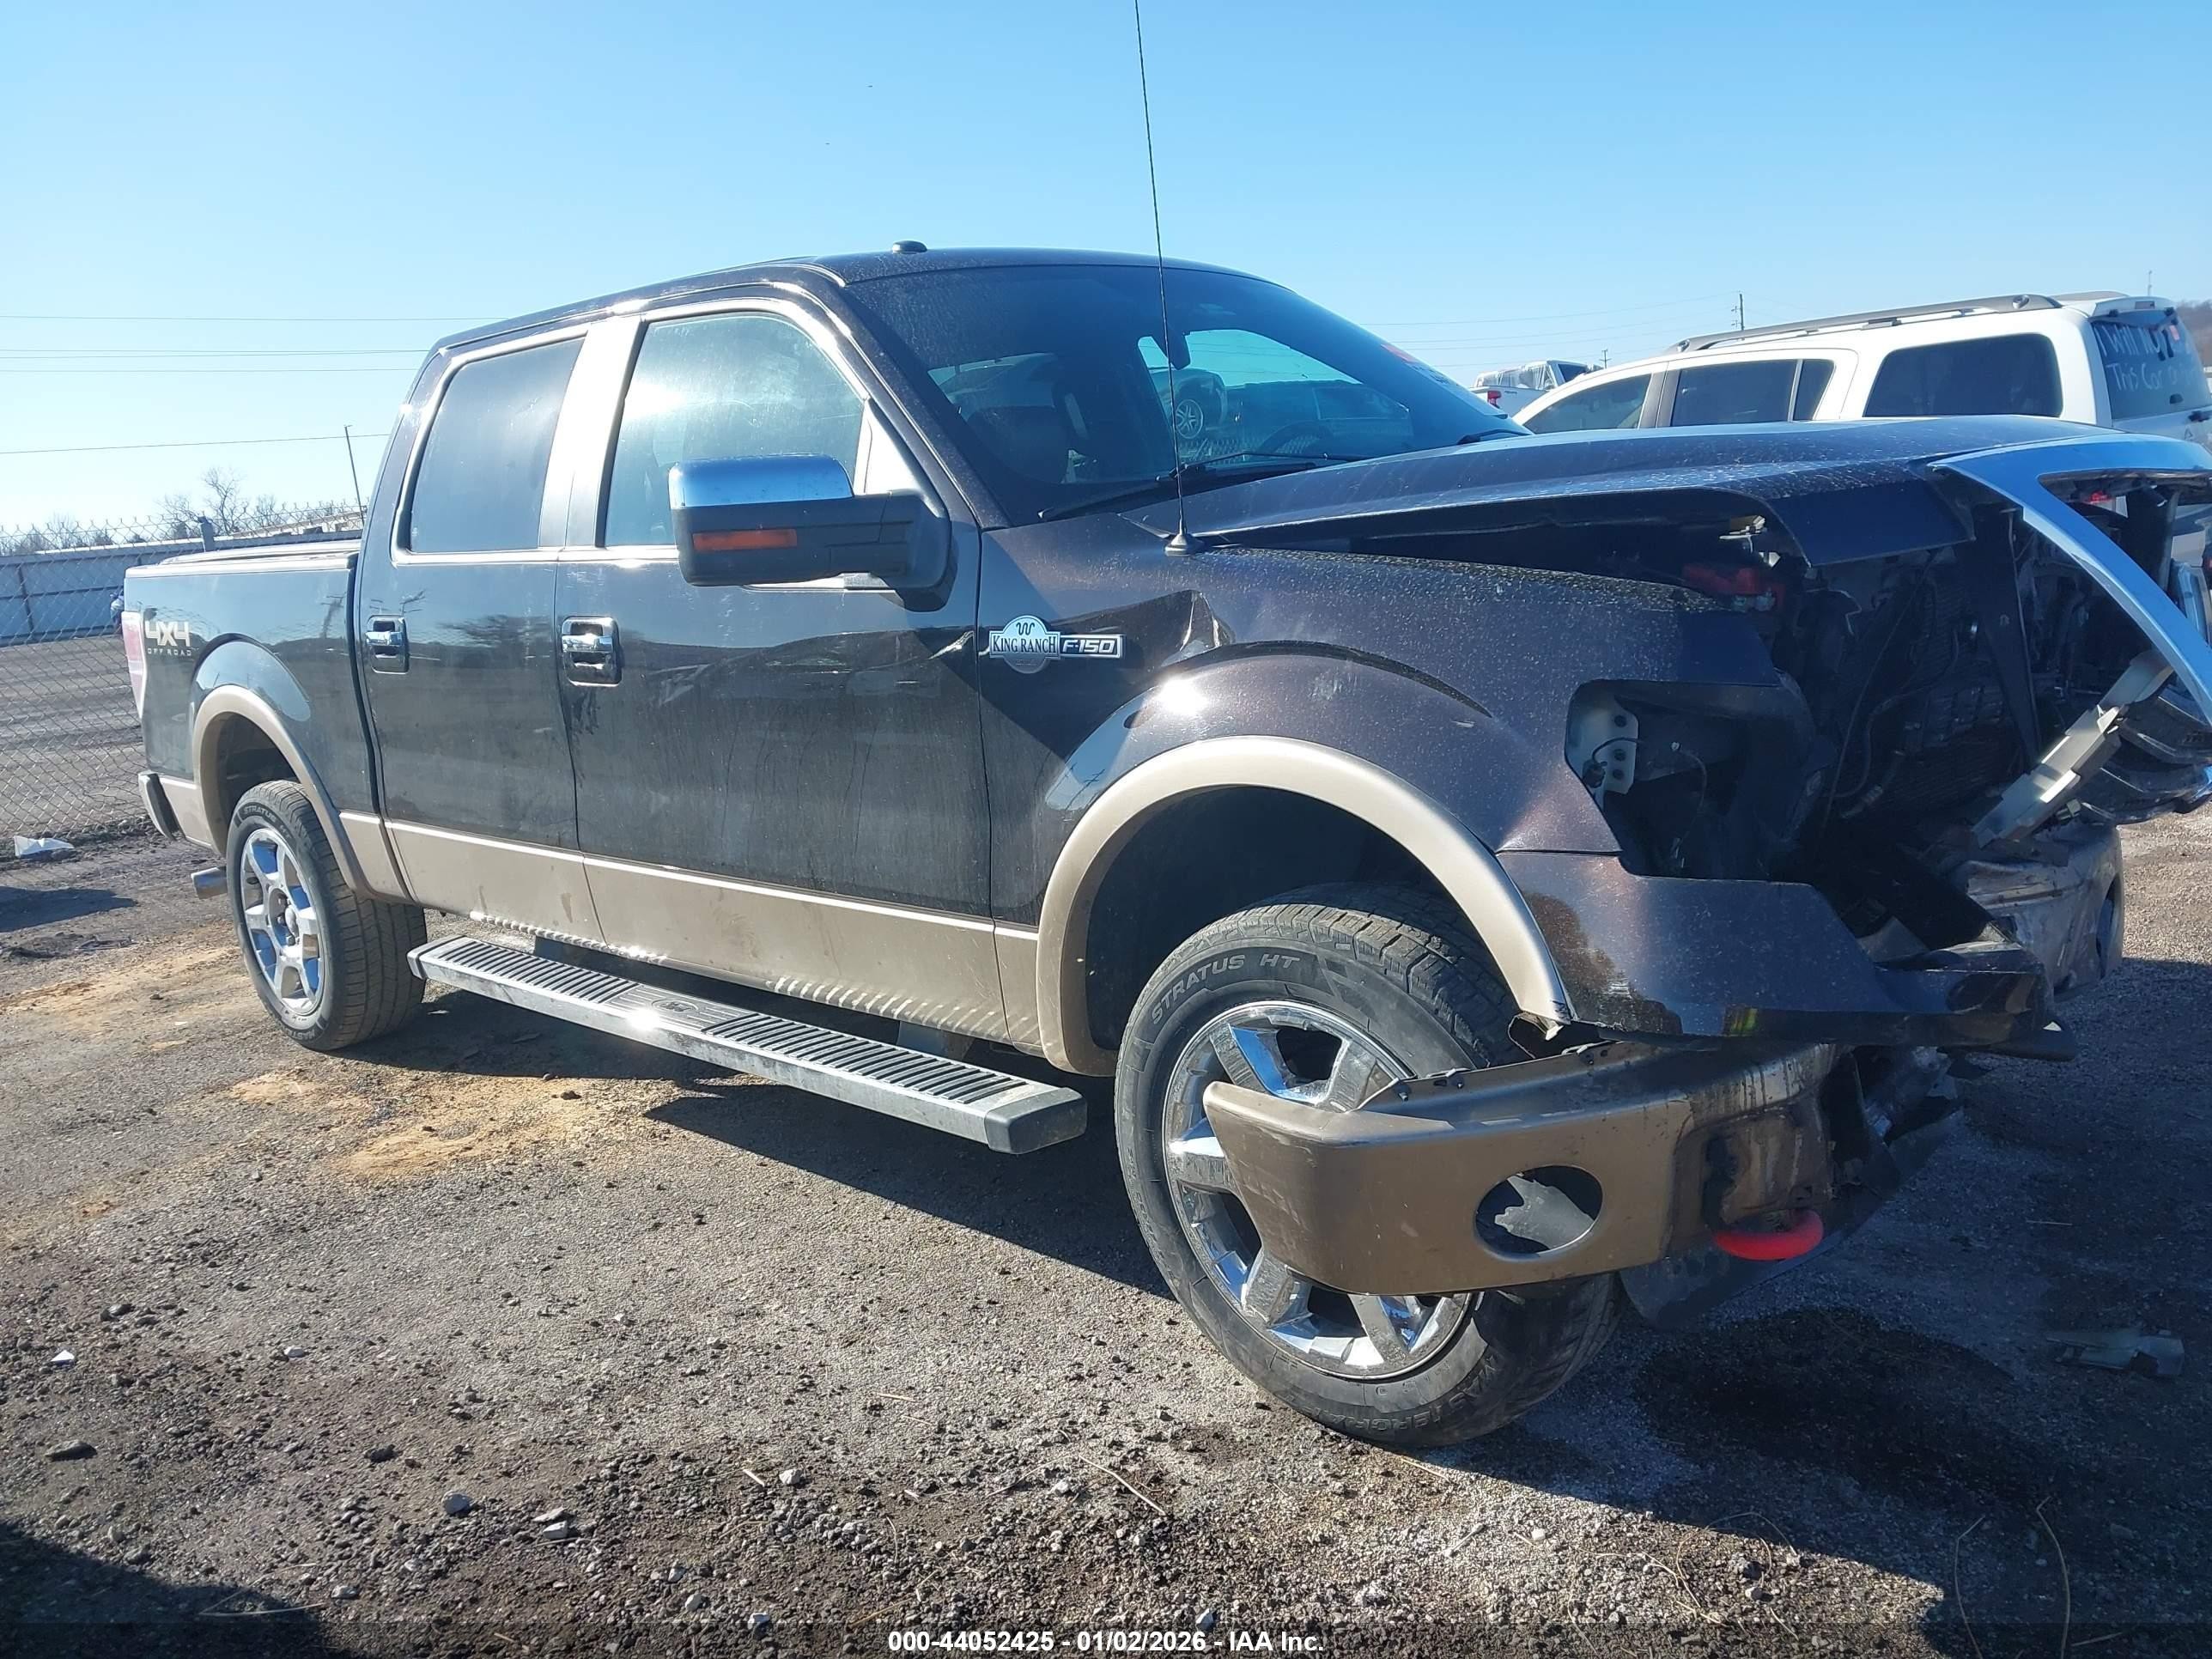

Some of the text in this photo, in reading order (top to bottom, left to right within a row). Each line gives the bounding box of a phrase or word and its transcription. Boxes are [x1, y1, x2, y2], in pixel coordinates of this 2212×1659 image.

[2106, 362, 2138, 391] This
[993, 635, 1057, 653] KING RANCH
[1062, 640, 1115, 653] F-150
[1151, 953, 1300, 1024] STRATUS HT
